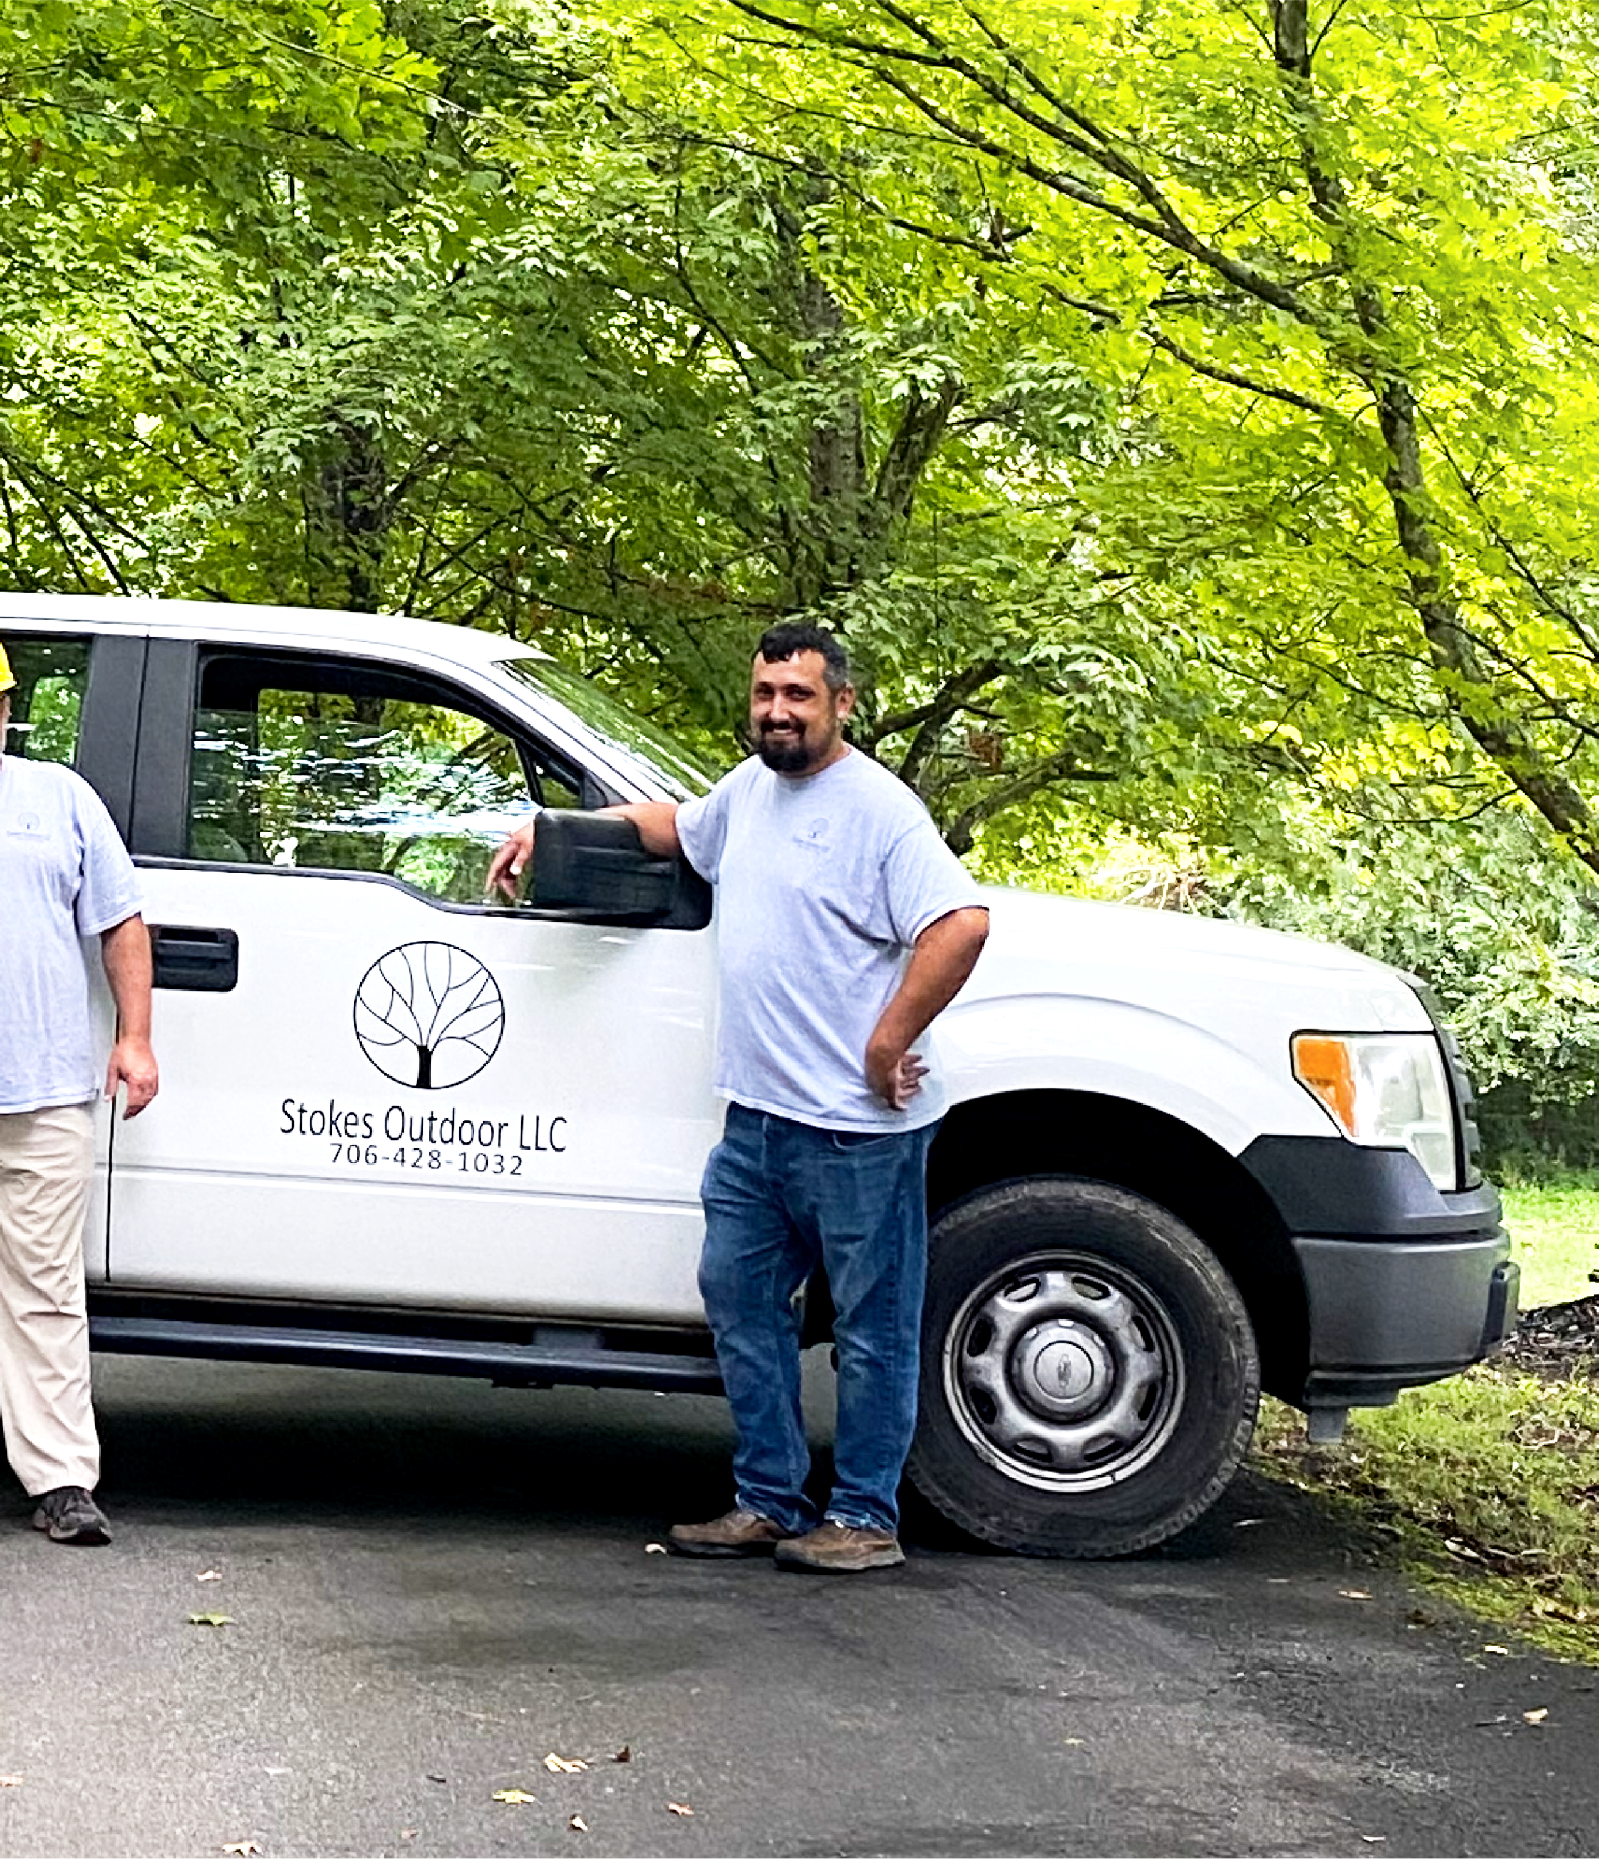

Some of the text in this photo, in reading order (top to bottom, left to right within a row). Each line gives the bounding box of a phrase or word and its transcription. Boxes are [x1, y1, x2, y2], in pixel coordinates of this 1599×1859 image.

[280, 1098, 568, 1153] Stokes Outdoor LLC
[330, 1142, 523, 1175] 706-428-1032
